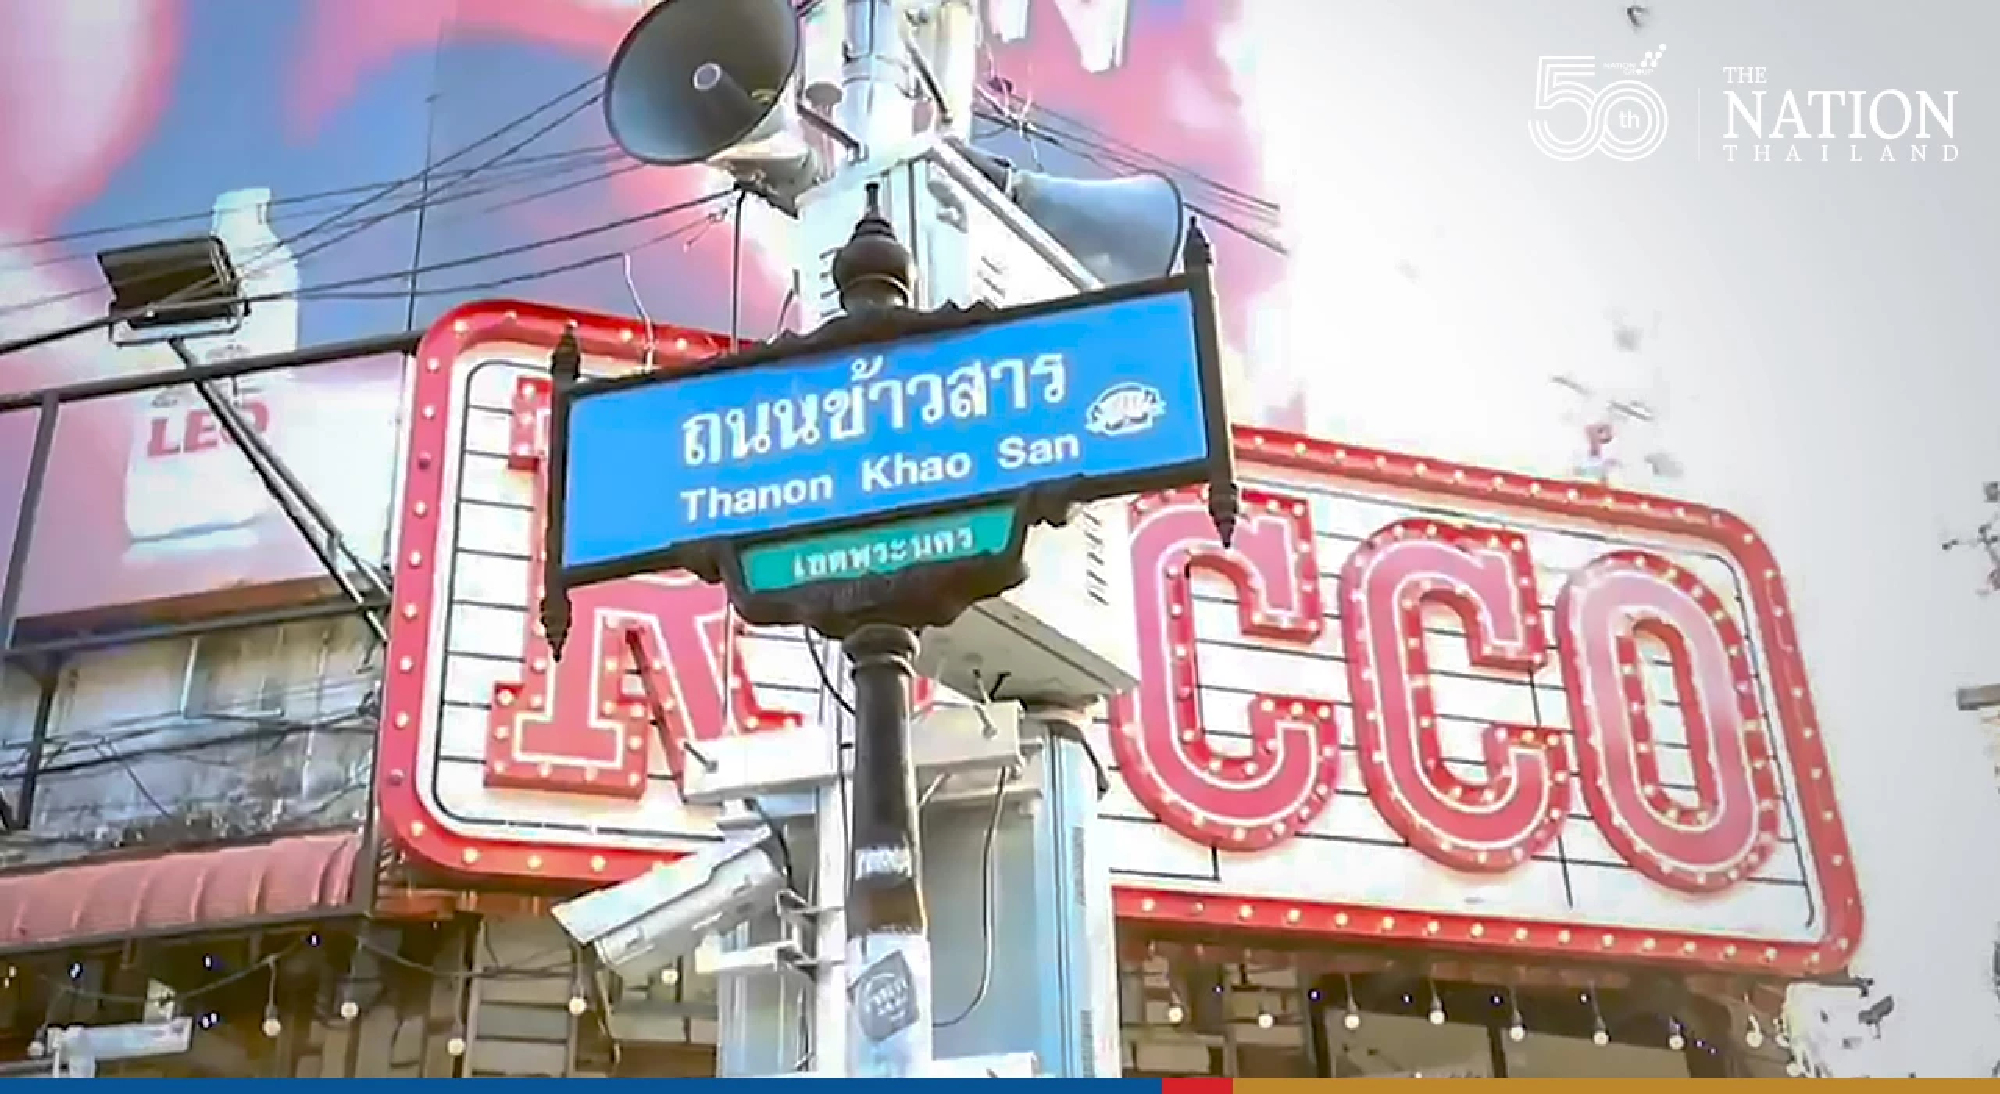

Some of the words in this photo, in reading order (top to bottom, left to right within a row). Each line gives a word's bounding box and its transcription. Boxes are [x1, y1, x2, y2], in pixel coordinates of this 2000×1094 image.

[681, 353, 1064, 466] ถนนข้าวสาร
[680, 474, 833, 522] Thanon
[860, 451, 971, 492] Khao
[997, 433, 1080, 471] San
[792, 526, 974, 579] เขตพระนคร
